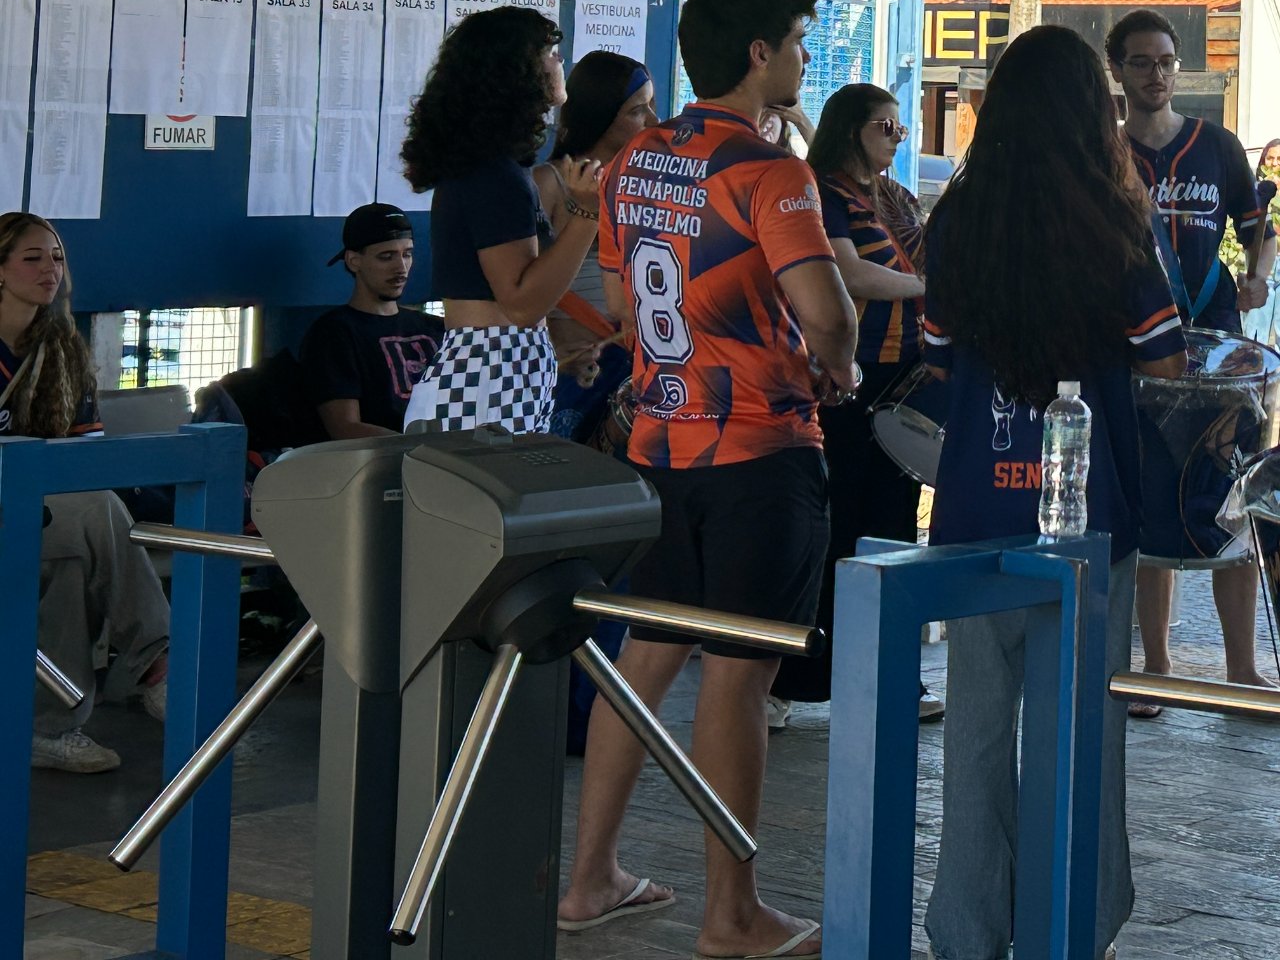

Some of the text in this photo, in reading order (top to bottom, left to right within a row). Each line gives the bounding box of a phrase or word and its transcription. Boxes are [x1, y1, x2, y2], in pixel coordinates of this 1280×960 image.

[332, 0, 374, 11] SALA 34
[424, 0, 436, 10] 35
[581, 2, 641, 18] VESTIBULAR
[585, 23, 635, 37] MEDICINA
[153, 127, 206, 144] FUMAR
[628, 149, 709, 179] MEDICINA
[616, 174, 708, 208] PENÁPOLIS
[616, 203, 702, 238] ANSELMO
[631, 236, 694, 366] 8
